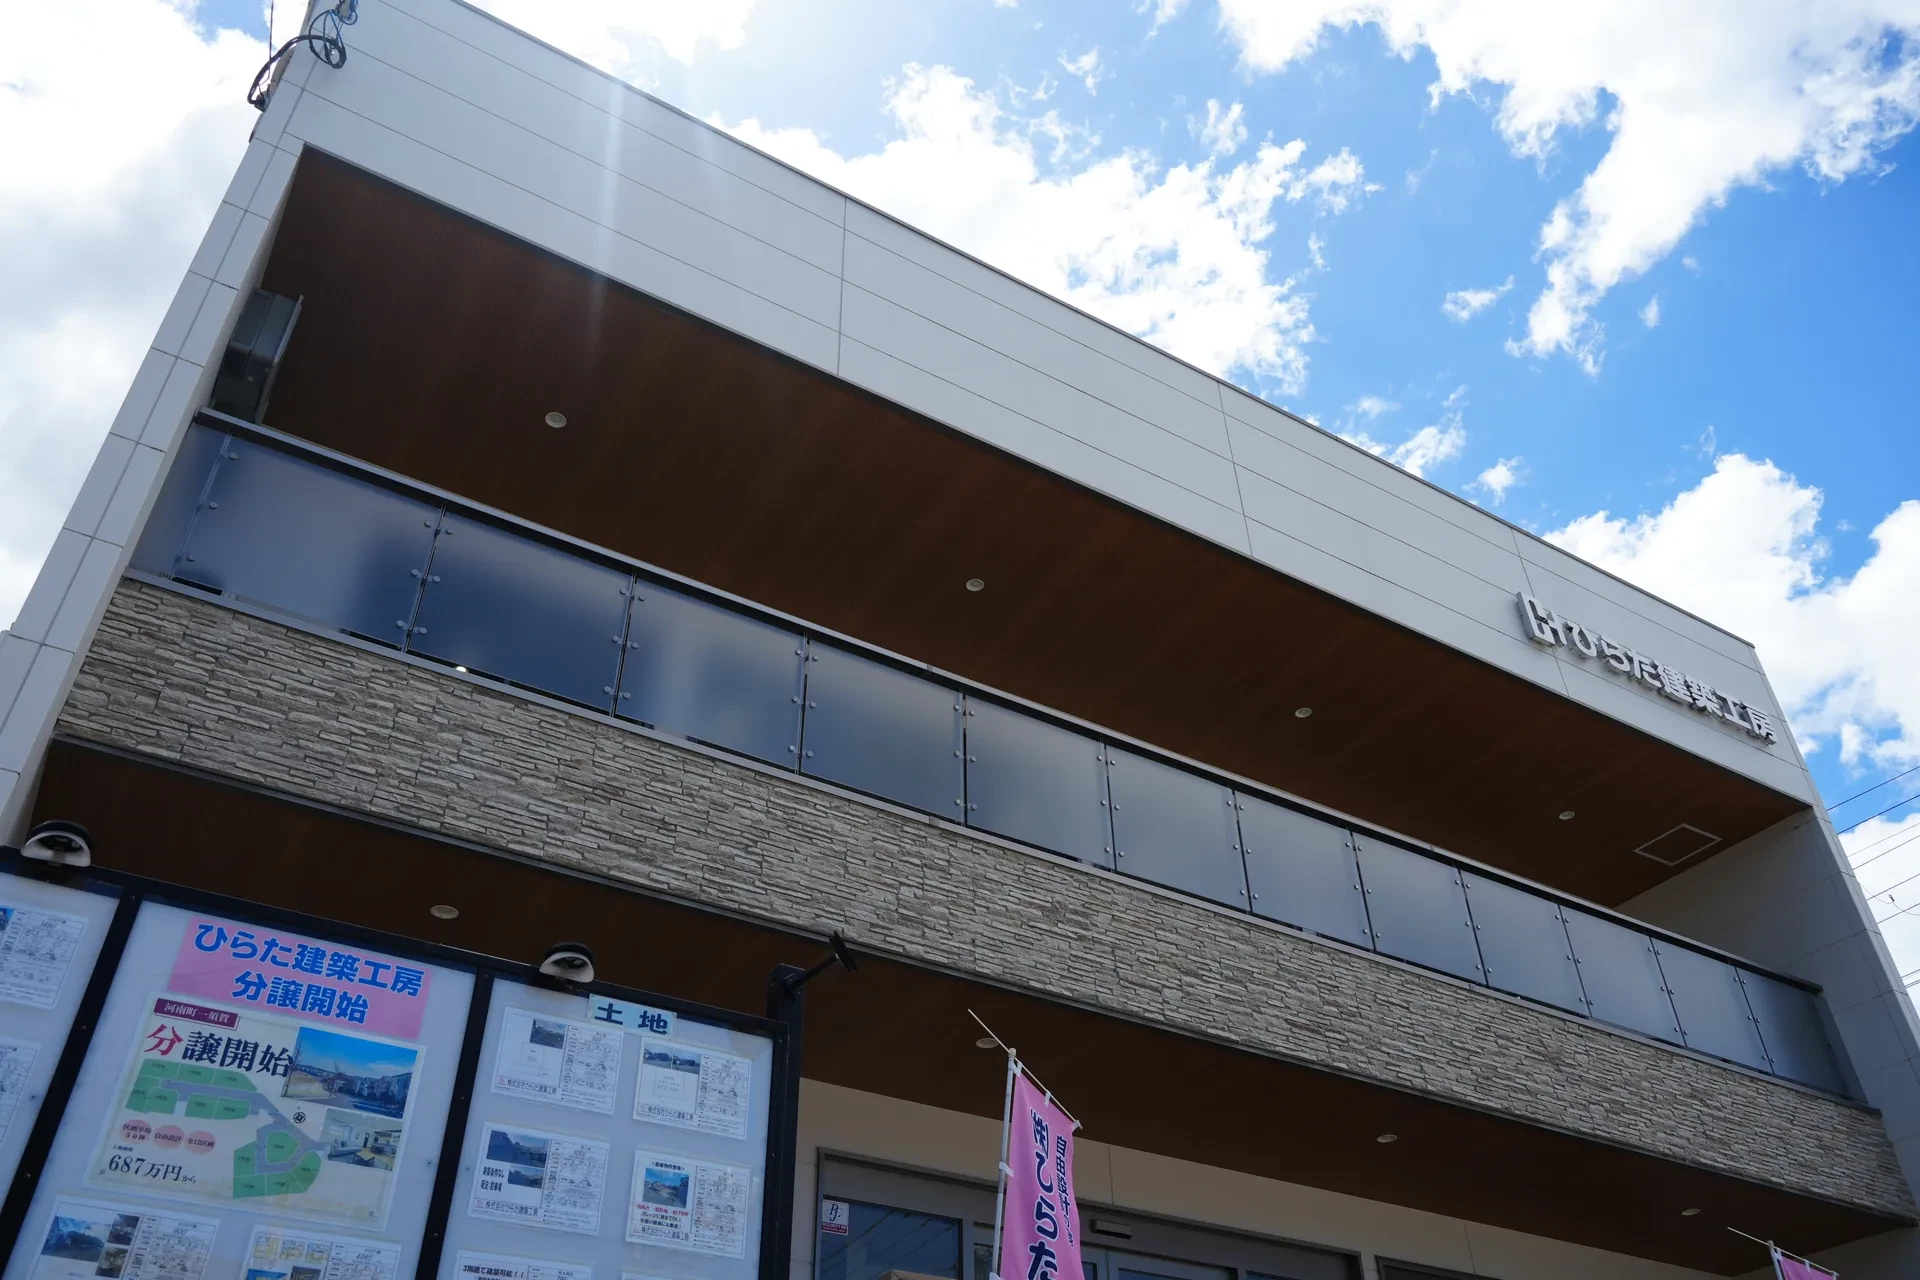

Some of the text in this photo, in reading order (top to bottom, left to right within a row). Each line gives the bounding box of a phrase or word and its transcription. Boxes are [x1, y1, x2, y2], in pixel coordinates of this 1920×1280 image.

[1564, 620, 1777, 745] ひらた建築工房
[194, 923, 425, 997] ひらた建築工房
[164, 1002, 230, 1024] 河南町一須賀
[232, 970, 369, 1024] 分譲開始
[144, 1023, 294, 1078] 分譲開始
[485, 1201, 538, 1217] 株式会社ひらた建築工房
